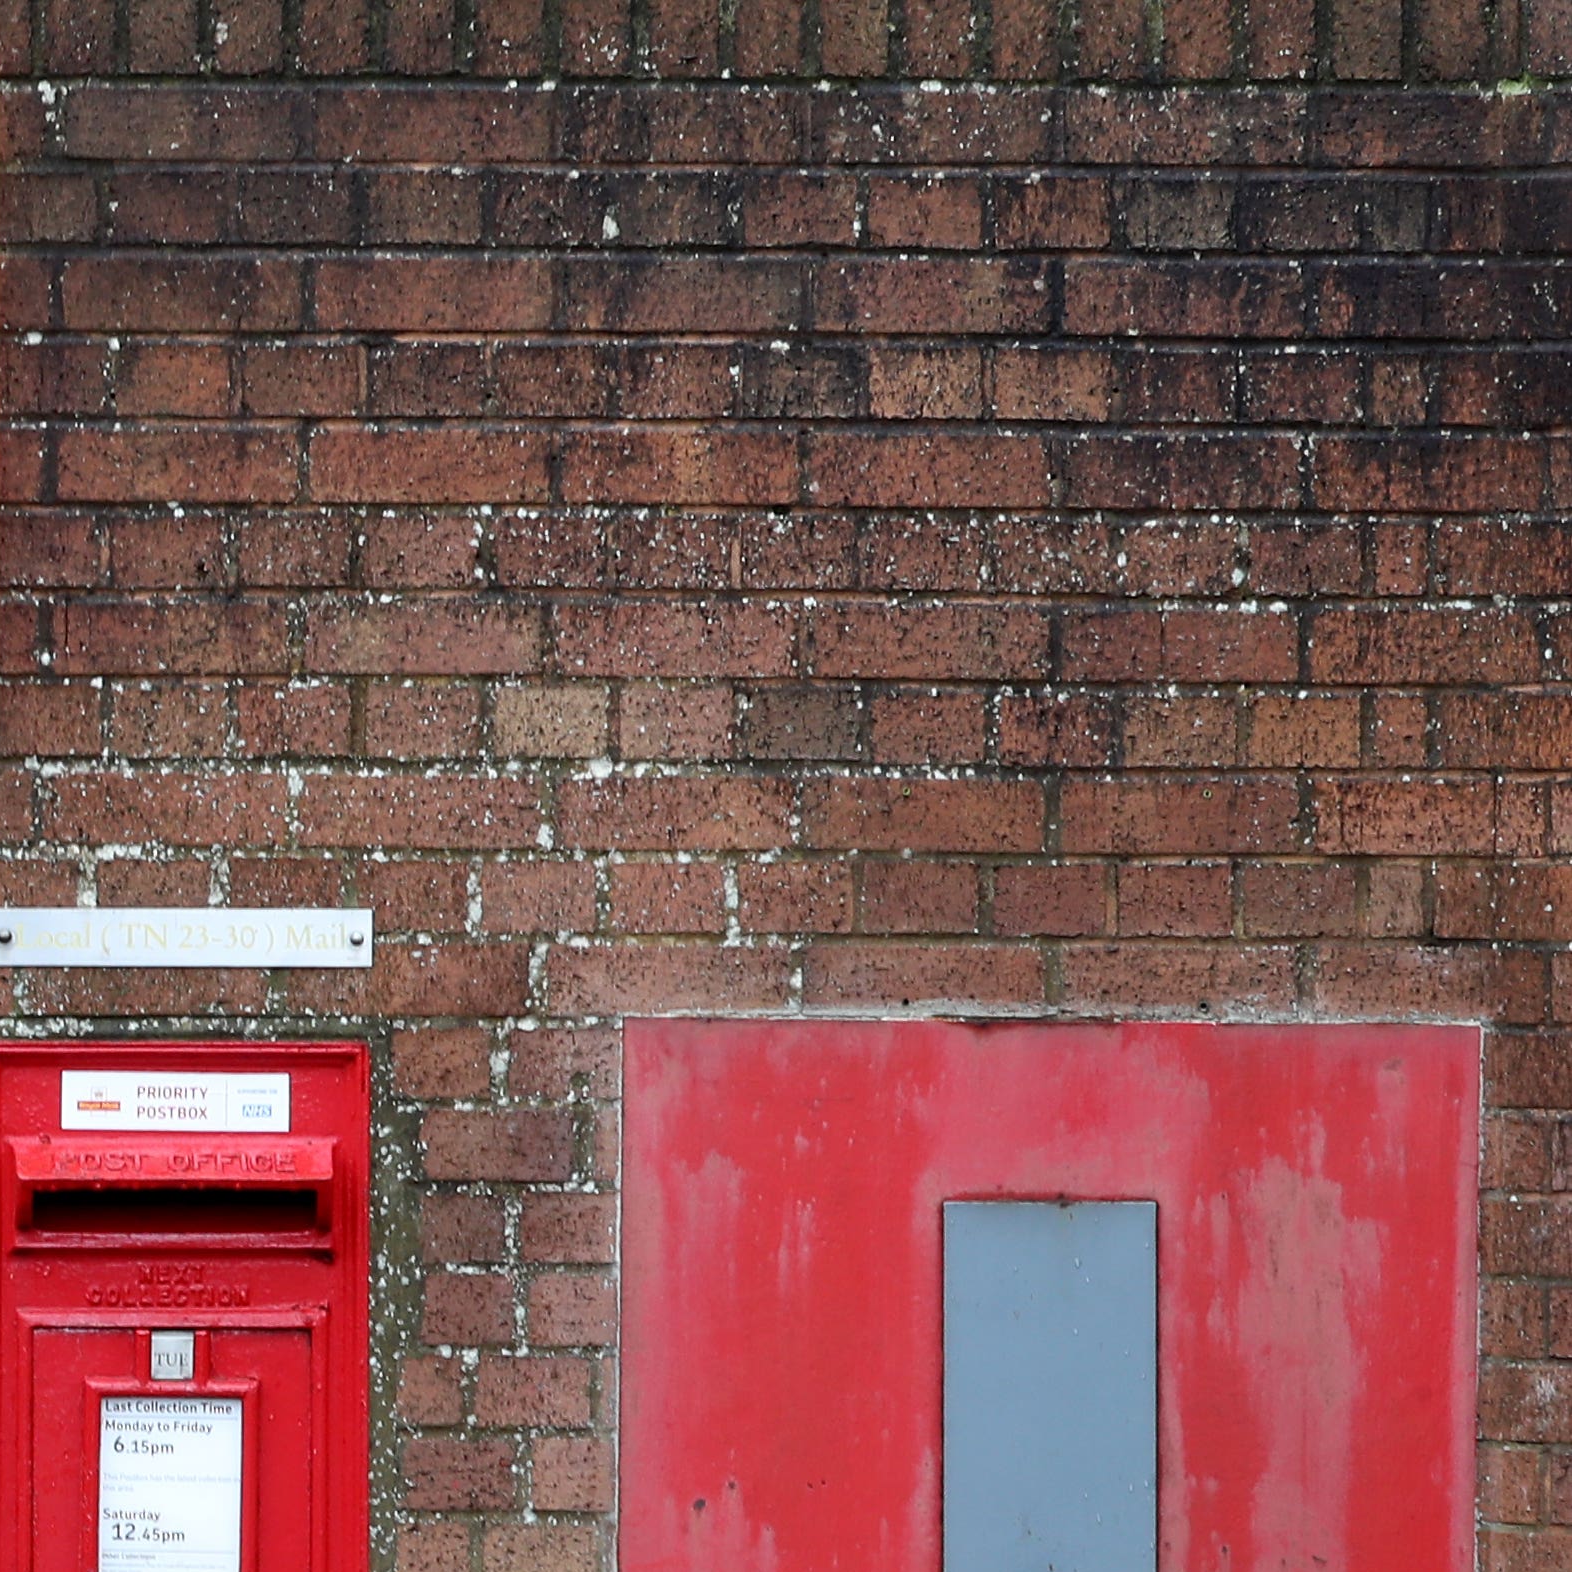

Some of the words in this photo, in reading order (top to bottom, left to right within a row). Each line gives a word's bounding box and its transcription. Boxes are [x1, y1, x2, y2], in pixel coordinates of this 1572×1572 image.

[15, 922, 92, 951] Local
[119, 923, 169, 951] TN
[178, 924, 259, 951] 23-30
[285, 923, 347, 951] Mail
[136, 1085, 209, 1101] PRIORITY
[136, 1104, 209, 1121] POSTBOX
[56, 1151, 149, 1173] POST
[167, 1151, 296, 1173] OFFICE
[137, 1265, 207, 1285] NEXT
[85, 1286, 251, 1308] COLLECTION
[105, 1400, 132, 1413] Last
[136, 1400, 198, 1415] Collection
[201, 1402, 233, 1415] Time
[105, 1420, 154, 1433] Monday
[157, 1421, 170, 1432] to
[173, 1421, 213, 1434] Friday
[113, 1436, 175, 1455] 6.15pm
[102, 1508, 161, 1522] Saturday
[112, 1523, 186, 1543] 12.45pm
